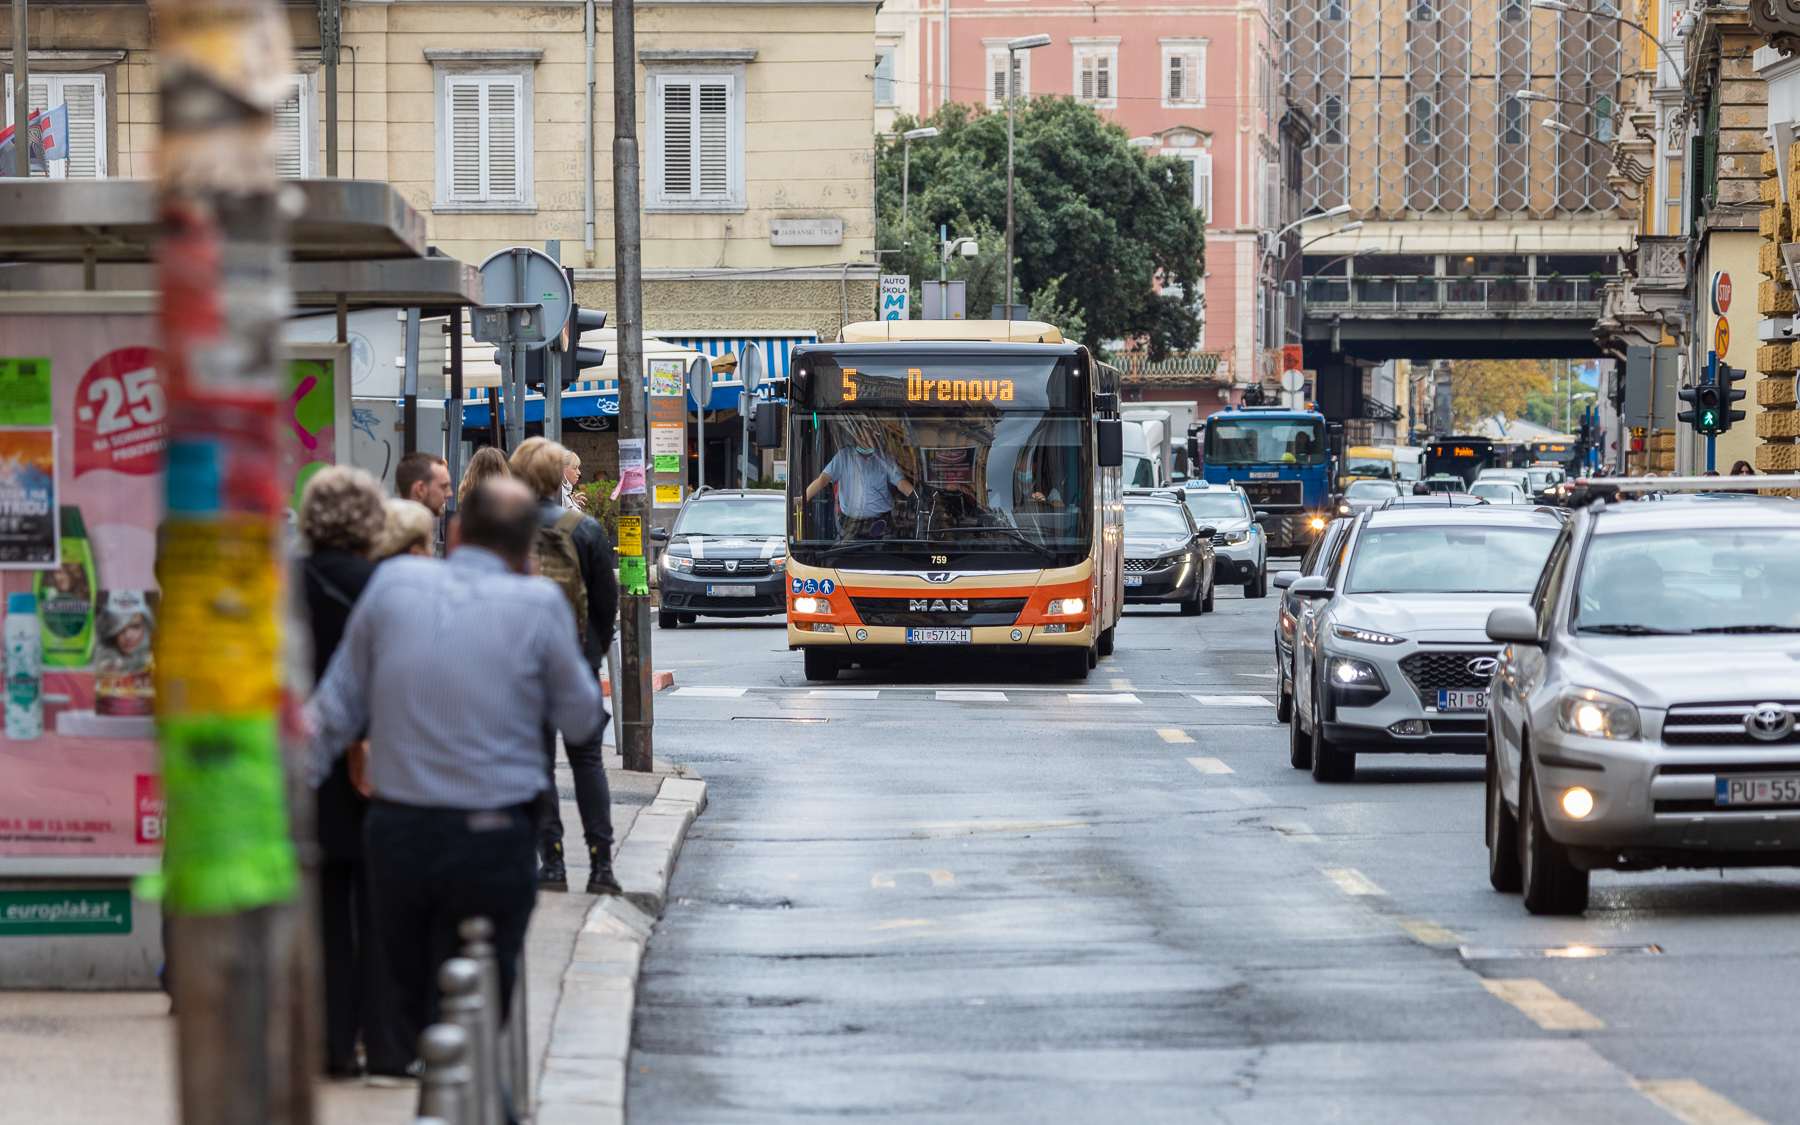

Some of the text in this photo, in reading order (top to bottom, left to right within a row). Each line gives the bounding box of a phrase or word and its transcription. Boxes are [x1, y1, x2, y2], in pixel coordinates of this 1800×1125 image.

[882, 286, 908, 294] ŠKOLA
[1719, 284, 1731, 301] STOP
[842, 368, 1014, 401] 5 Drenova
[931, 555, 947, 564] 759
[909, 599, 969, 612] MAN
[913, 630, 967, 641] RI 5712-H
[1448, 692, 1463, 708] RI
[1731, 780, 1800, 802] PU 55
[6, 899, 111, 921] europlakat
